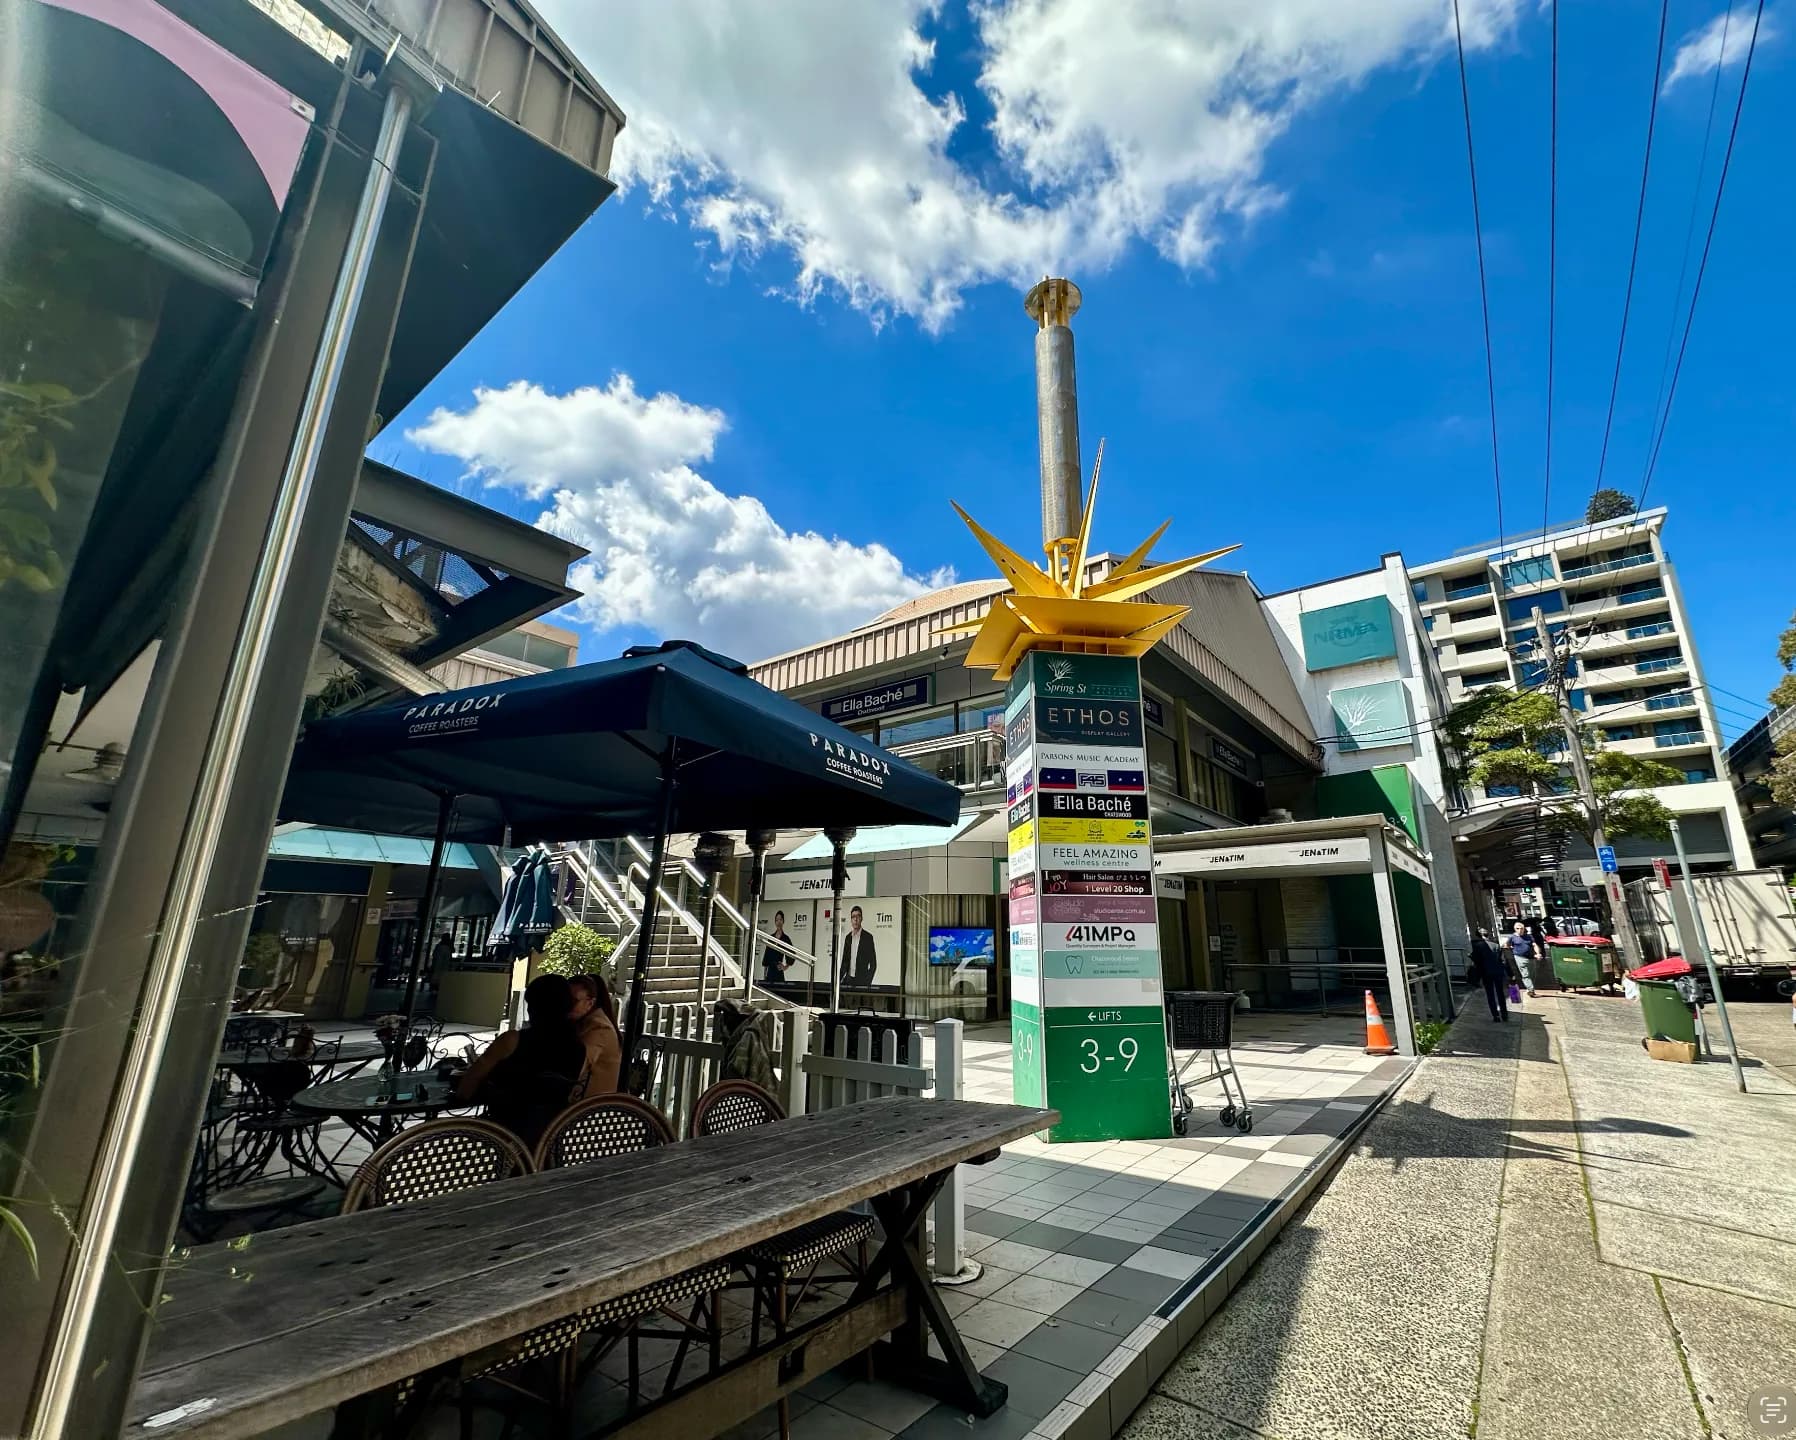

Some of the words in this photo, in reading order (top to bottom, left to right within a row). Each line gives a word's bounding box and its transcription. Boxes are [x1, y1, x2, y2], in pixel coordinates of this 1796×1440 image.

[1044, 682, 1074, 695] Spring
[1077, 684, 1087, 693] St
[403, 693, 507, 720] PARADOX
[842, 699, 863, 713] Ella
[864, 687, 903, 707] Baché
[408, 720, 438, 733] COFFEE
[440, 716, 480, 730] ROASTERS
[1047, 707, 1130, 726] ETHOS
[1010, 712, 1031, 746] ETHOS
[809, 733, 891, 775] PARADOX
[1040, 752, 1074, 761] PARSONS
[1076, 754, 1101, 762] MUSIC
[1104, 755, 1140, 763] ACADEMY
[826, 757, 852, 772] COFFEE
[852, 766, 884, 785] ROASTERS
[1078, 772, 1107, 788] F45
[1057, 795, 1084, 810] Ella
[1088, 796, 1132, 812] Baché
[1053, 847, 1080, 858] FEEL
[1084, 848, 1138, 859] AMAZING
[1209, 853, 1245, 864] JEN&TIM
[1299, 846, 1340, 857] JEN&TIM
[1064, 859, 1101, 867] wellness
[1102, 859, 1130, 867] centre
[1091, 885, 1112, 893] Level
[1113, 885, 1123, 893] 20
[1124, 885, 1145, 895] Shop
[794, 912, 808, 923] Jen
[876, 912, 893, 923] Tim
[1098, 1011, 1122, 1021] LIFTS
[1017, 1029, 1033, 1066] 3-9
[1079, 1037, 1139, 1074] 3-9
